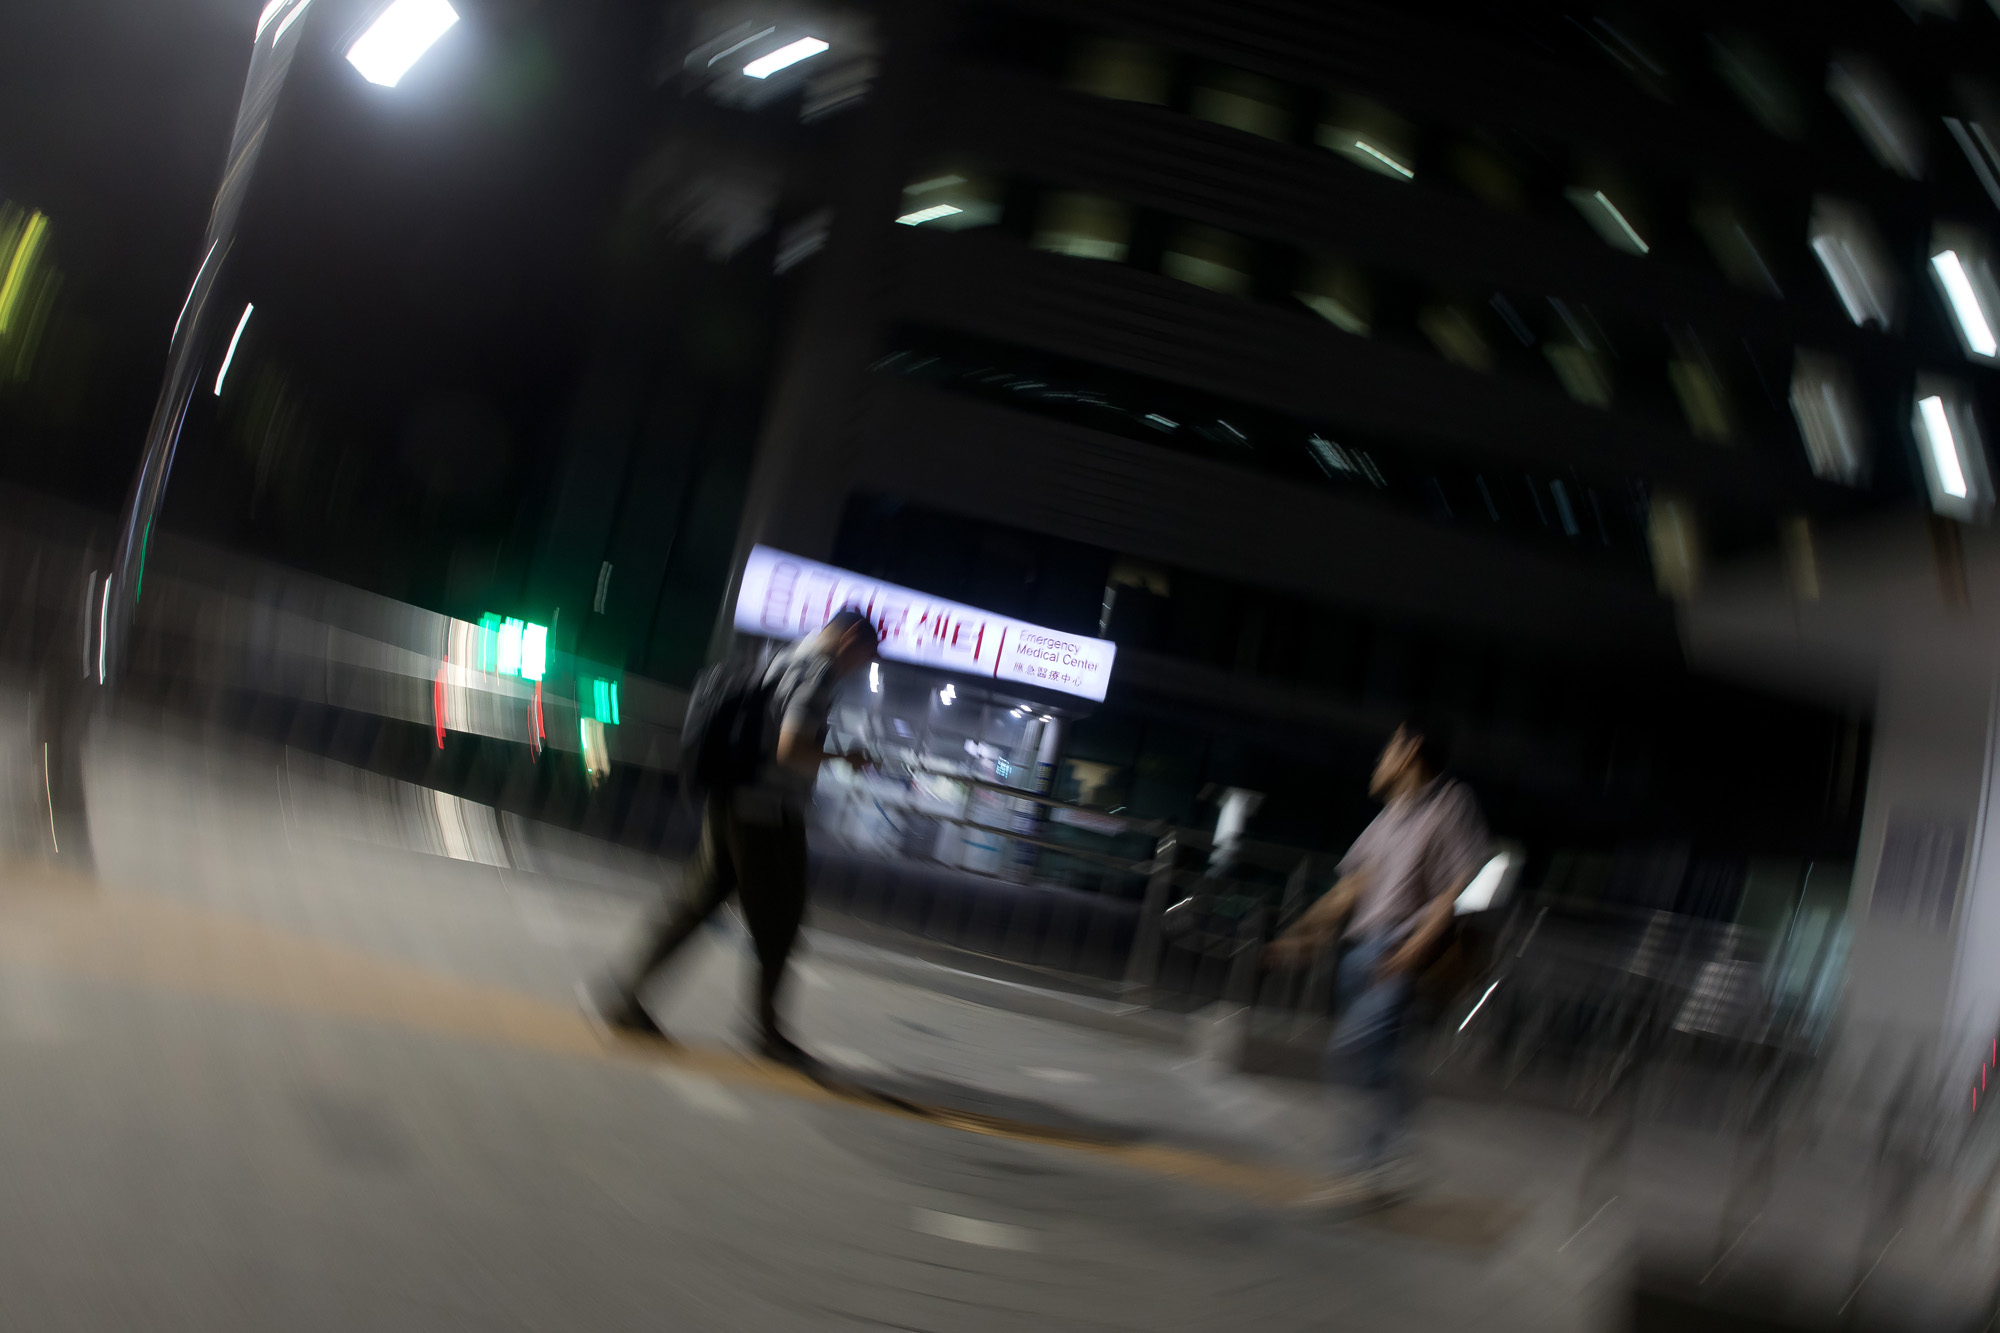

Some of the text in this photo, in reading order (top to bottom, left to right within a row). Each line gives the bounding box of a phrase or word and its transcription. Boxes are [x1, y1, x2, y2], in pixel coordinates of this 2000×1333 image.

[1020, 629, 1081, 655] Emergency
[1017, 644, 1098, 672] Medical Center
